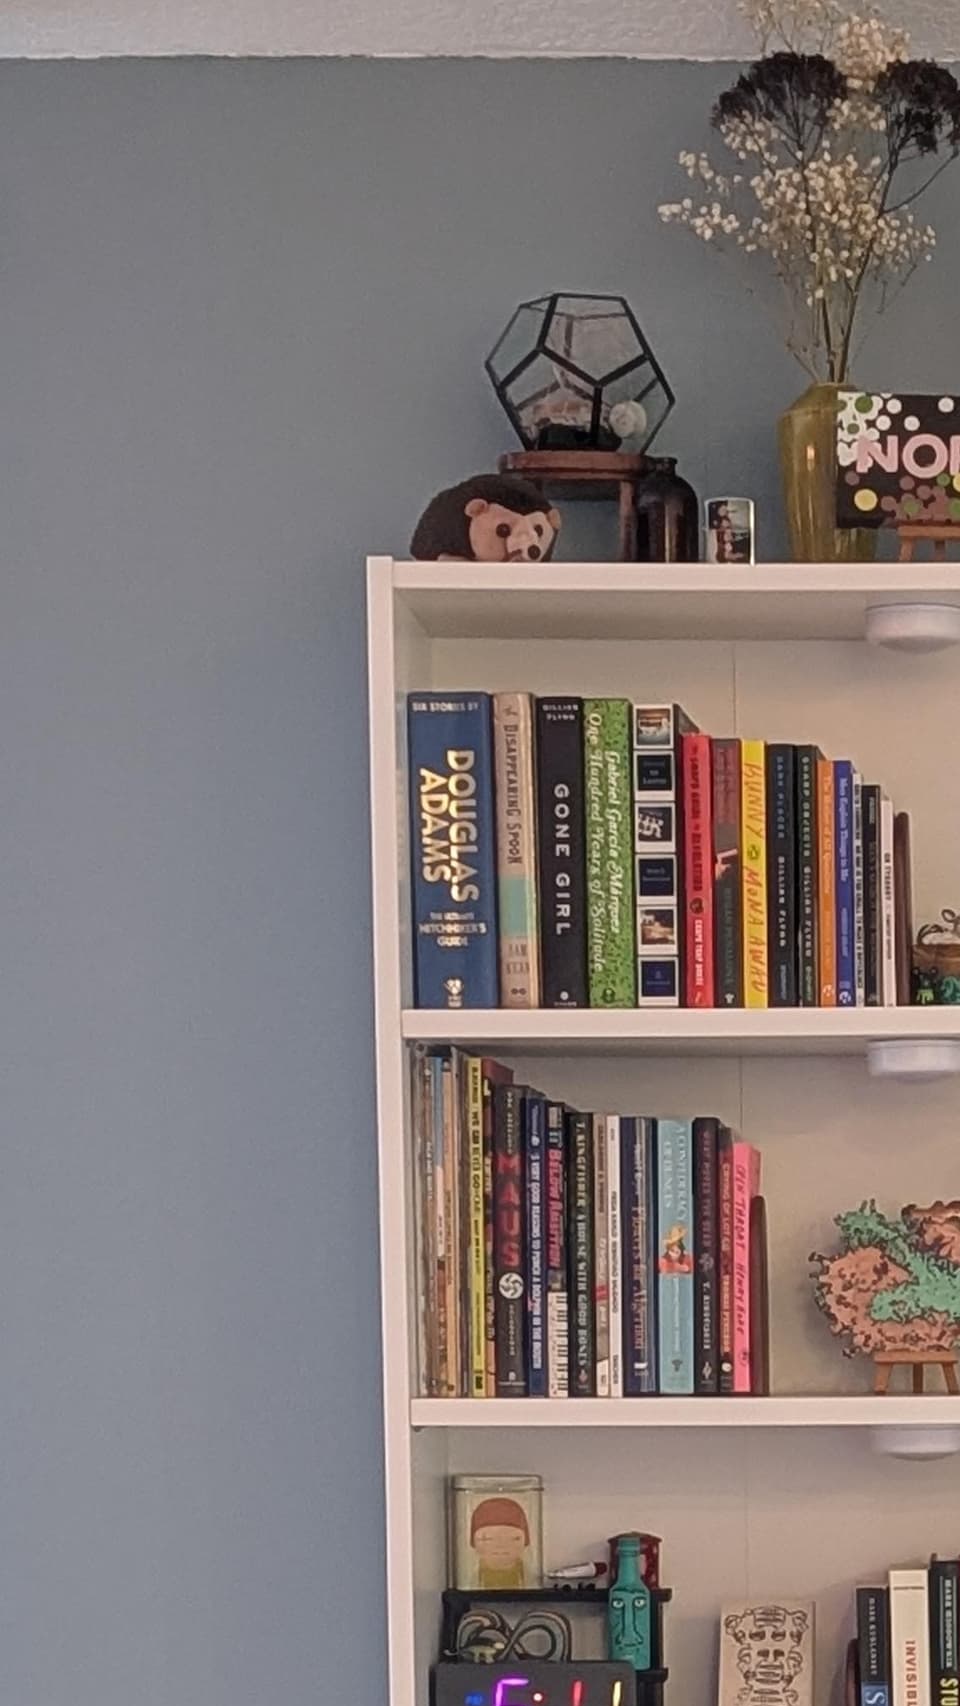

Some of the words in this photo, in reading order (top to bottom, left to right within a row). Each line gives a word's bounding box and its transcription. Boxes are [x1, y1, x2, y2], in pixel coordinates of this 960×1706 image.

[587, 712, 602, 747] One
[504, 724, 522, 817] DISAPPEARING
[589, 751, 604, 822] Hundred
[605, 751, 621, 806] Gabriel
[744, 762, 764, 840] BUNNY
[420, 769, 451, 883] ADAMS
[447, 750, 480, 902] DOUGLAS
[507, 822, 523, 865] SPOON
[554, 783, 571, 858] GONE
[590, 827, 605, 875] Years
[606, 808, 622, 858] García
[555, 872, 571, 936] GIRL
[591, 880, 606, 896] of
[606, 860, 623, 935] Márquez
[591, 902, 607, 972] Solitude
[498, 1152, 522, 1267] MAUS
